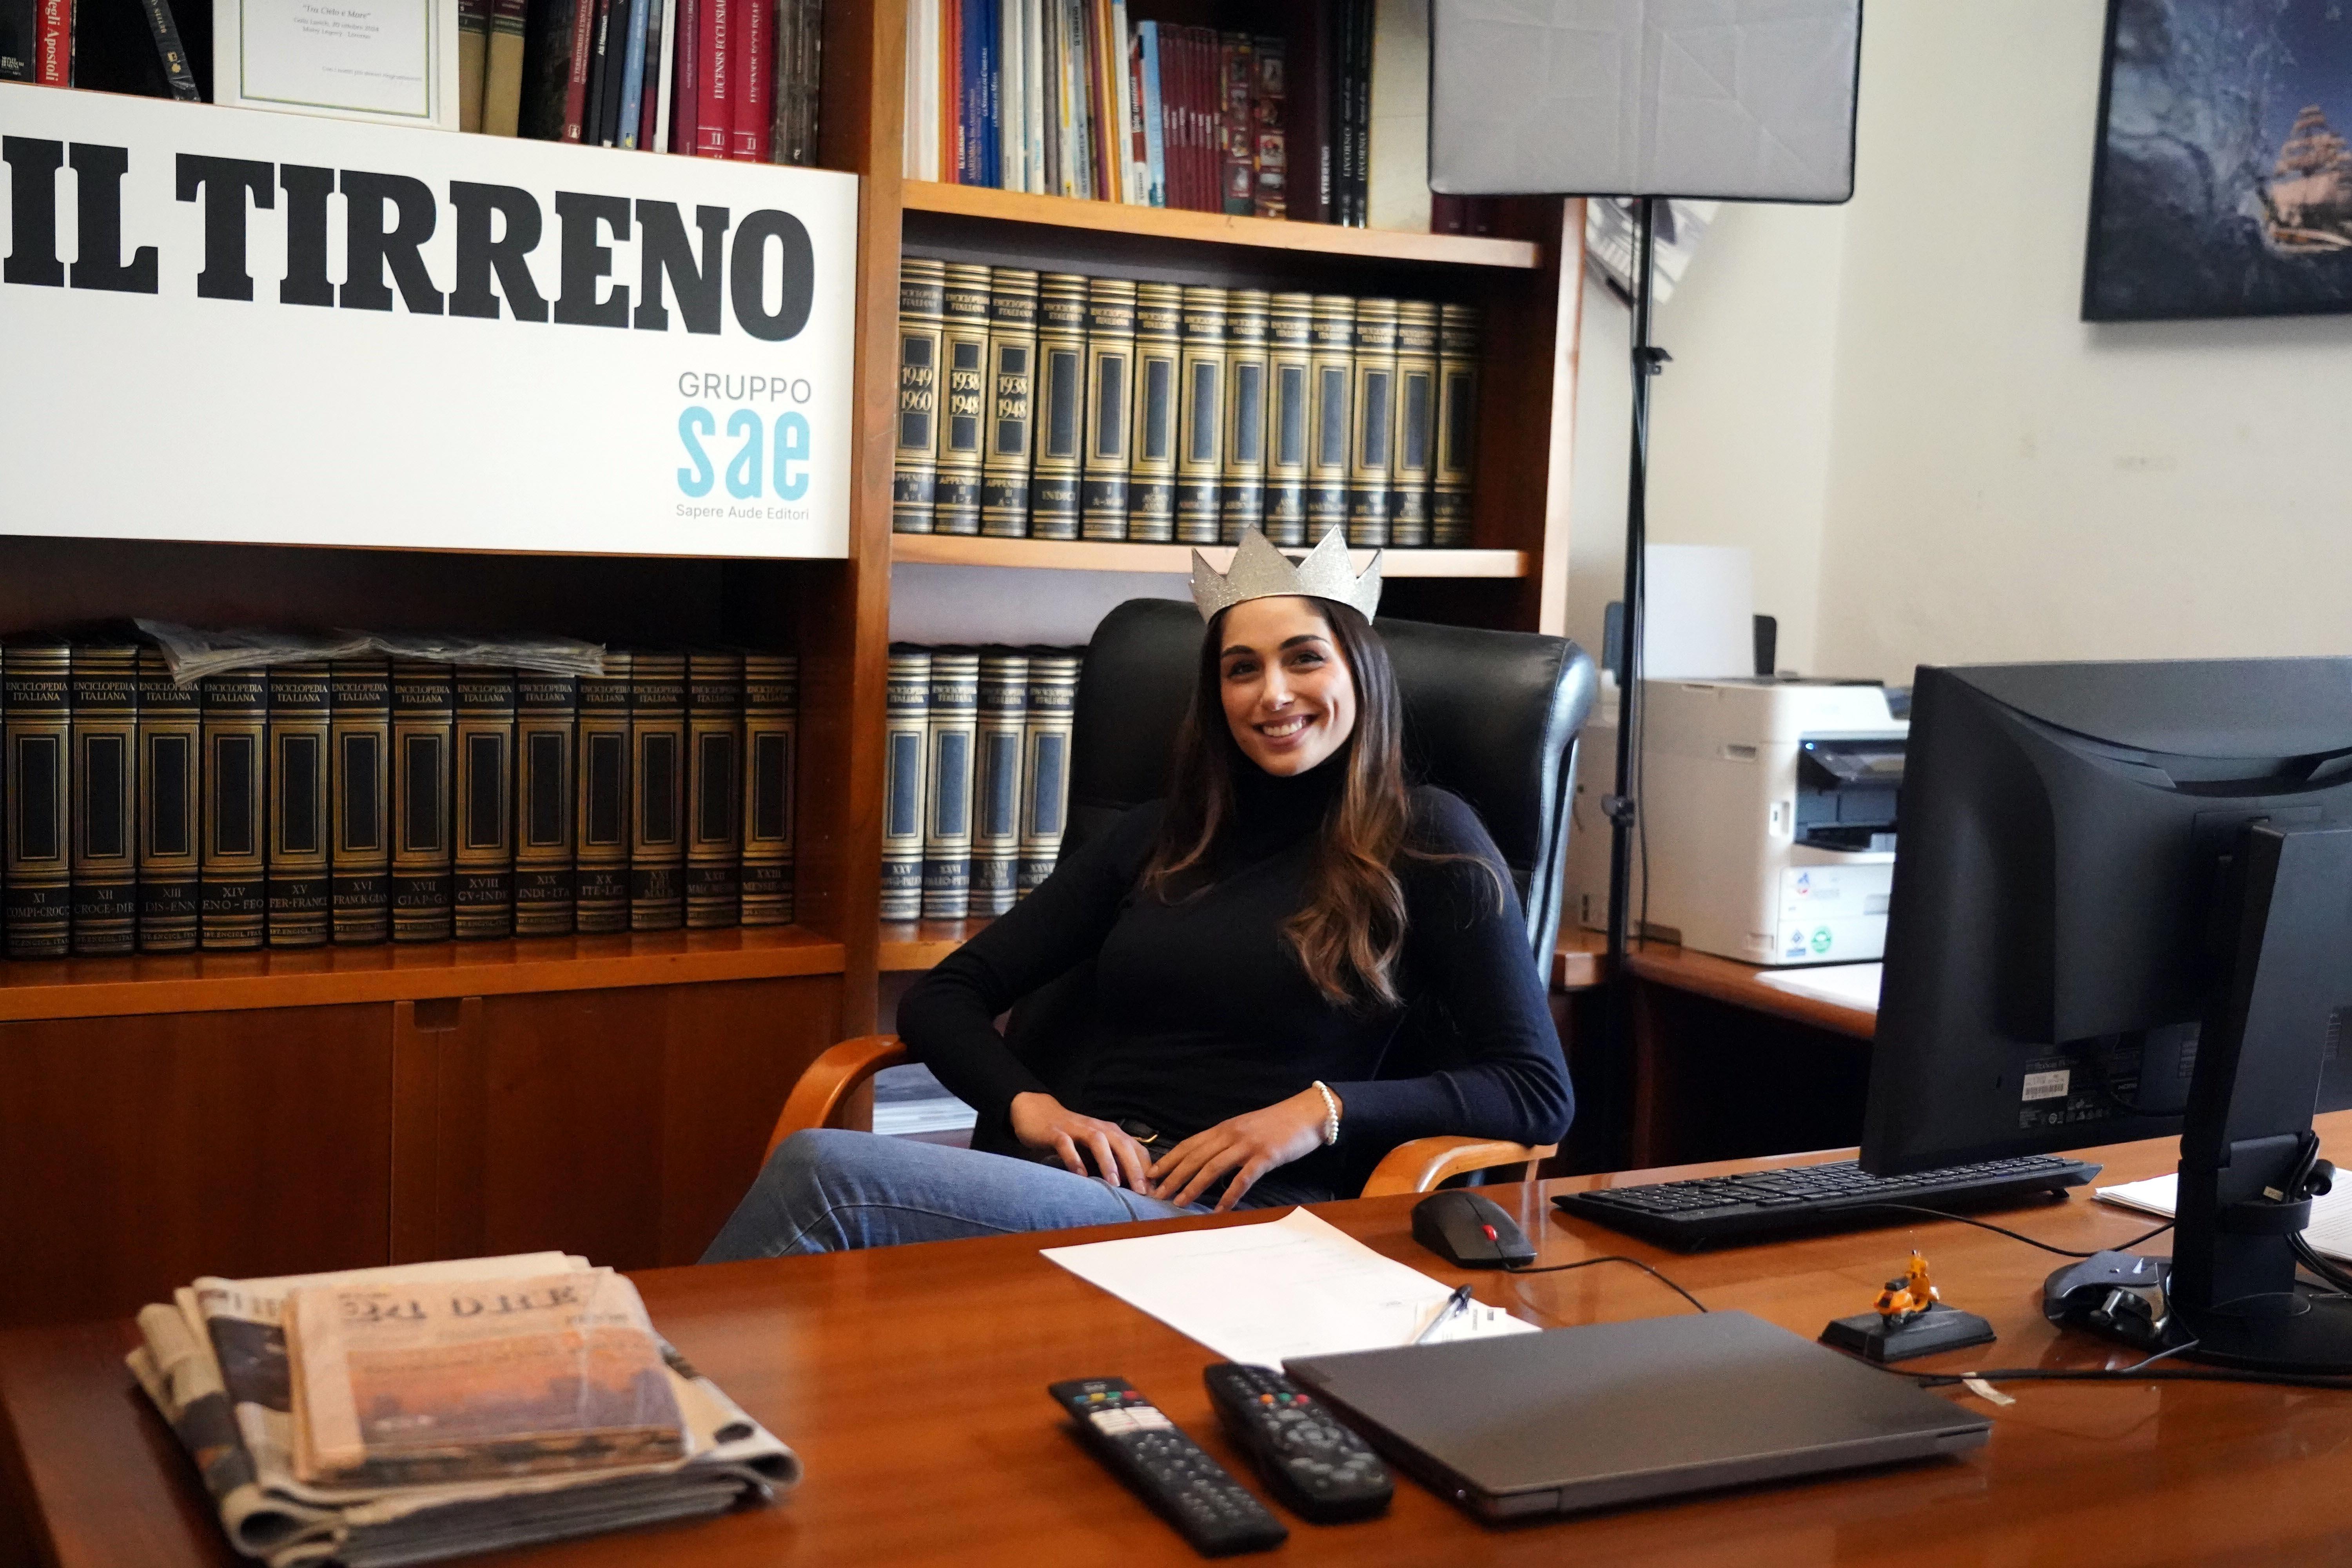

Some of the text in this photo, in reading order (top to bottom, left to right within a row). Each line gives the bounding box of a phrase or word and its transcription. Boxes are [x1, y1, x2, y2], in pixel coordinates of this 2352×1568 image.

[44, 0, 60, 82] egli Apostoli
[575, 34, 585, 74] TERRITORIO
[713, 52, 725, 99] LUCENSIS
[1343, 127, 1352, 177] LIVORNO
[1358, 132, 1367, 181] LIVORNO
[2, 135, 815, 342] IL TIRRENO
[902, 367, 933, 388] 1949
[952, 372, 980, 392] 1938
[679, 372, 811, 404] GRUPPO
[999, 376, 1027, 396] 1938
[901, 390, 932, 411] 1960
[951, 394, 979, 415] 1948
[998, 399, 1027, 419] 1948
[677, 406, 810, 501] sae
[676, 504, 809, 520] Sapere Aude Editori
[6, 682, 68, 692] ENCICLOPEDIA
[73, 682, 136, 692] ENCICLOPEDIA
[205, 683, 263, 693] ENCICLOPEDIA
[271, 683, 328, 693] ENCICLOPEDIA
[332, 683, 388, 692] ENCICLOPEDIA
[395, 685, 450, 694] ENCICLOPEDIA
[458, 684, 512, 693] ENCICLOPEDIA
[519, 684, 572, 693] ENCICLOPEDIA
[13, 692, 61, 702] ITALIANA
[80, 691, 127, 701] ITALIANA
[147, 692, 191, 701] ITALIANA
[211, 693, 257, 702] ITALIANA
[277, 693, 321, 702] ITALIANA
[338, 692, 381, 701] ITALIANA
[401, 695, 443, 703] ITALIANA
[464, 693, 505, 702] ITALIANA
[526, 693, 566, 702] ITALIANA
[586, 693, 626, 702] ITALIANA
[640, 694, 678, 703] ITALIANA
[469, 878, 499, 888] XVIII
[537, 875, 557, 885] XIX
[596, 875, 612, 885] XX
[292, 885, 308, 895] XV
[353, 881, 373, 891] XVI
[411, 881, 436, 892] XVII
[97, 889, 113, 900] XII
[163, 887, 181, 898] XIII
[223, 887, 246, 898] XIV
[34, 893, 45, 904] XI
